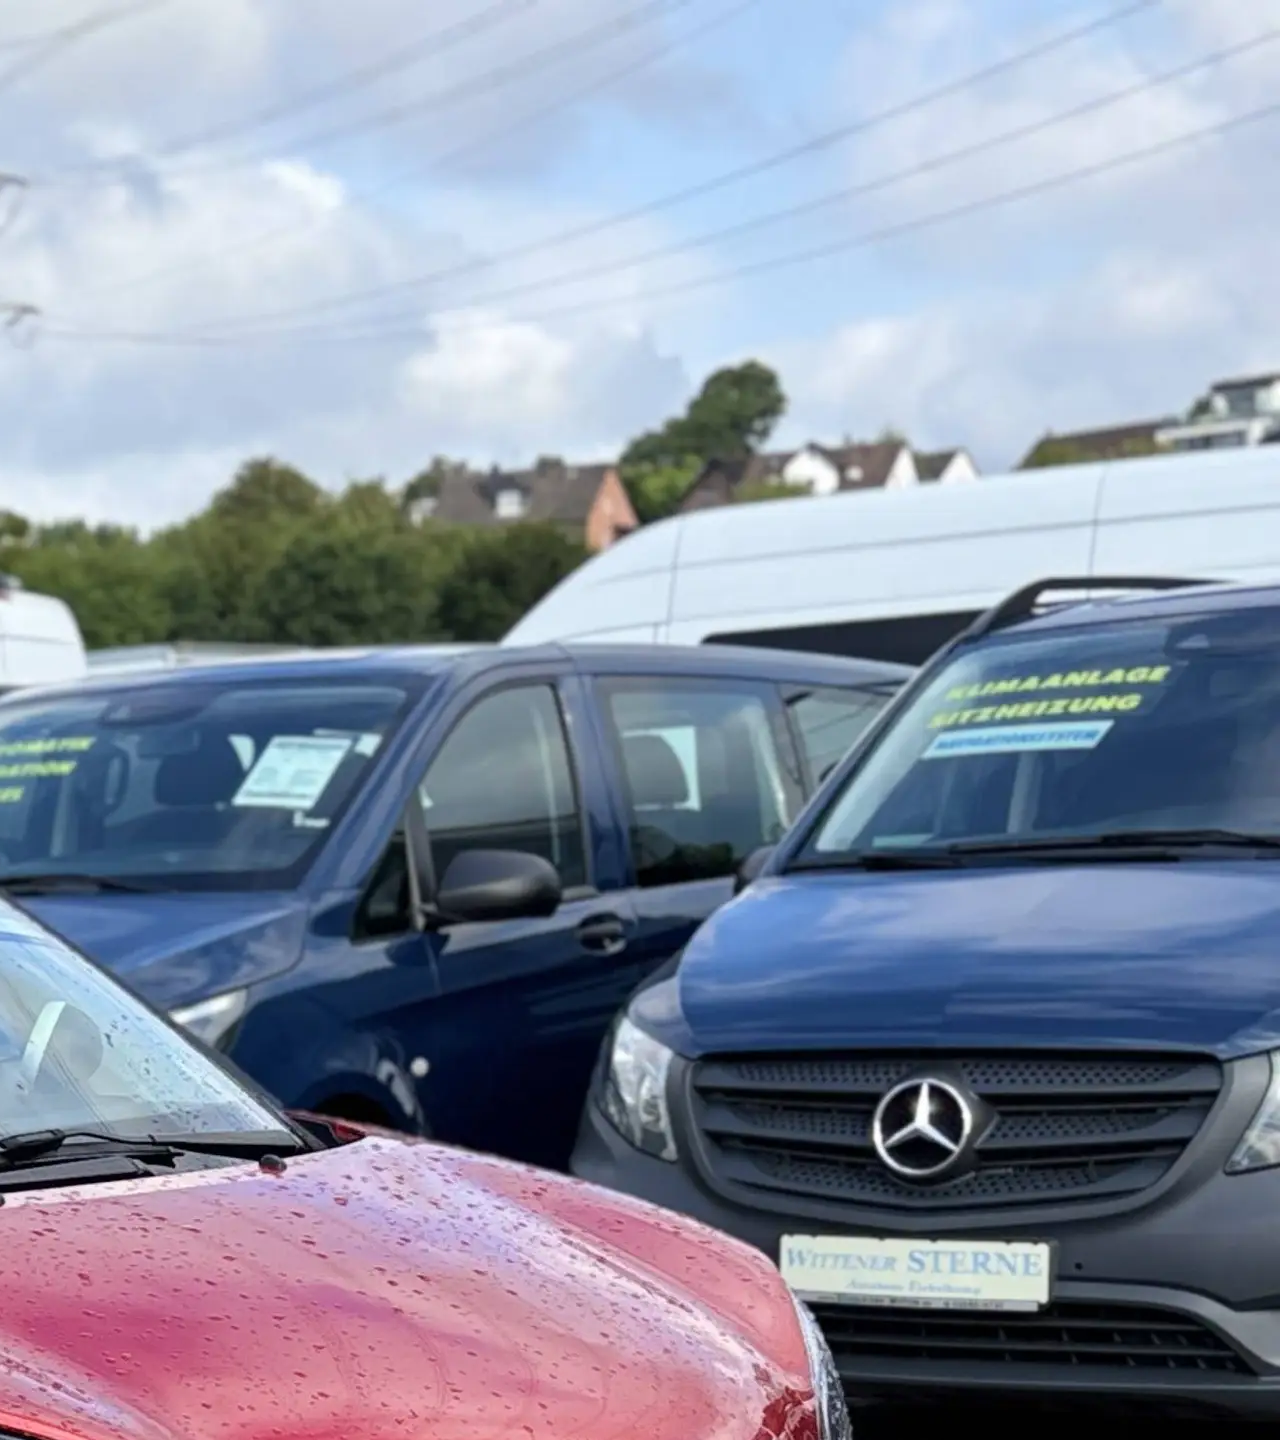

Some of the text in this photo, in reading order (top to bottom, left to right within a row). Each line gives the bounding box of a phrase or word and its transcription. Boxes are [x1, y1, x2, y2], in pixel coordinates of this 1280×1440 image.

[946, 666, 1171, 699] KLIMAANLAGE
[928, 694, 1142, 728] SITZHEIZUNG
[787, 1247, 1042, 1277] WITTENER STERNE
